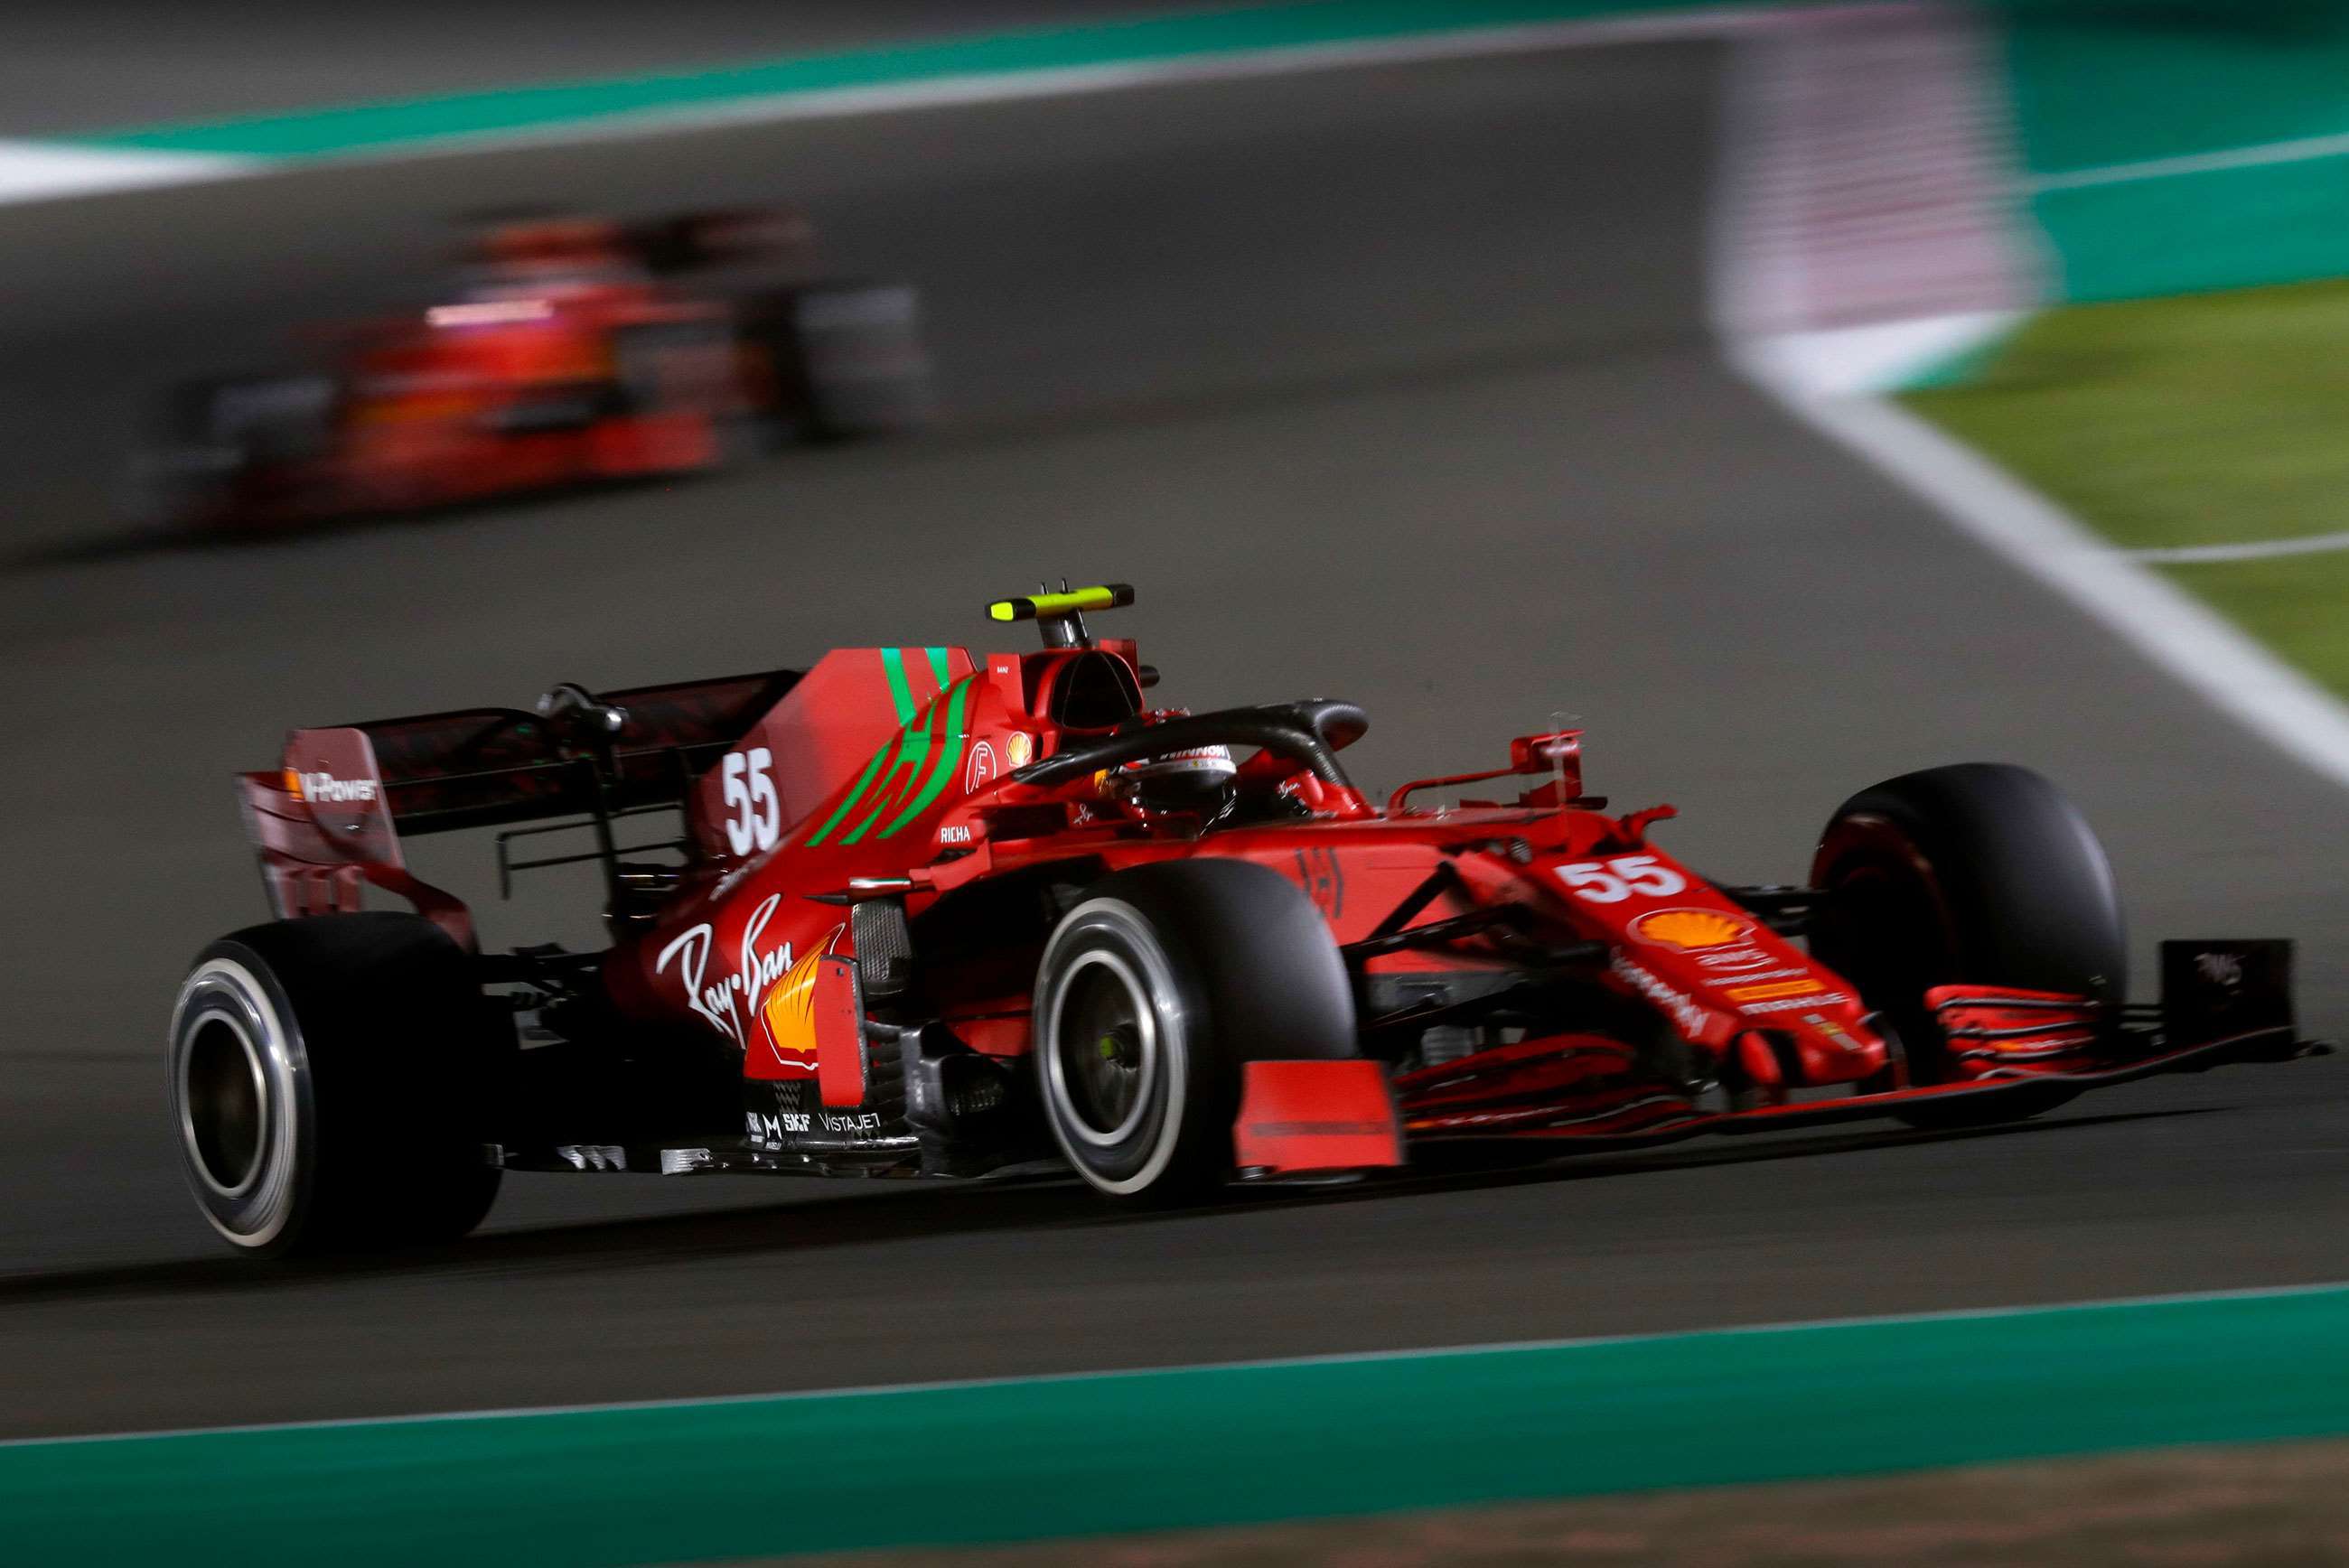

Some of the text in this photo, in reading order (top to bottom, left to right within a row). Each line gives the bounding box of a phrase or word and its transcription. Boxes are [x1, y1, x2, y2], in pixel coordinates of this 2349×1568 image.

[723, 747, 780, 856] 55
[941, 826, 970, 843] RICHA
[1554, 856, 1686, 903] 55
[782, 1114, 810, 1132] SKF
